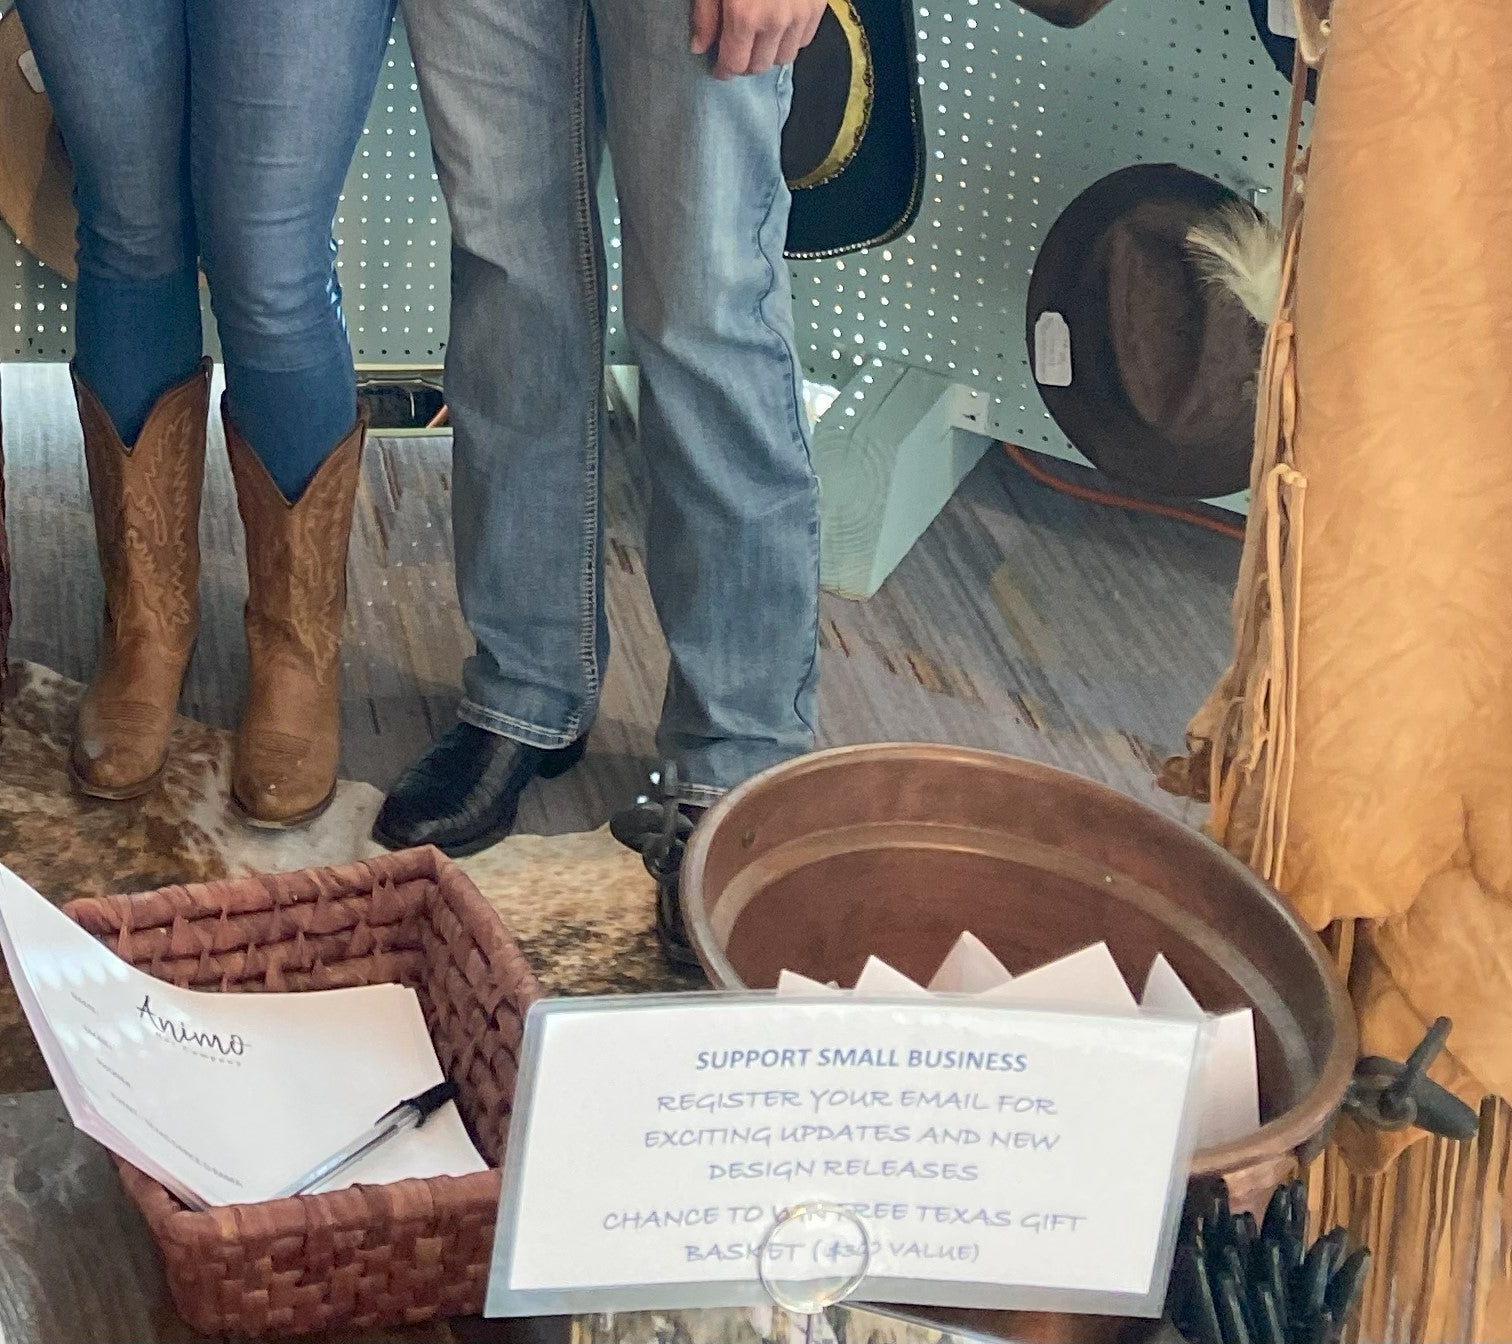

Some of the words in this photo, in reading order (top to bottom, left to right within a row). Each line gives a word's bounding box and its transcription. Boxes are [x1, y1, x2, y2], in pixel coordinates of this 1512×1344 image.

[137, 995, 251, 1056] Animo
[695, 1048, 813, 1071] SUPPORT
[816, 1048, 900, 1068] SMALL
[907, 1049, 1029, 1073] BUSINESS
[656, 1088, 803, 1114] REGISTER
[810, 1089, 896, 1114] YOUR
[899, 1090, 991, 1111] EMAIL
[996, 1094, 1058, 1116] FOR
[644, 1125, 773, 1150] EXCITING
[780, 1124, 912, 1144] UPDATES
[916, 1125, 982, 1146] AND
[988, 1129, 1061, 1151] NEW
[708, 1159, 817, 1183] DESIGN
[823, 1159, 979, 1181] RELEASES
[602, 1207, 721, 1230] CHANCE
[726, 1204, 764, 1224] TO
[914, 1204, 1012, 1228] TEXAS
[1020, 1212, 1088, 1234] GIFT
[684, 1241, 805, 1263] BASKET
[885, 1240, 981, 1263] VALUE)
